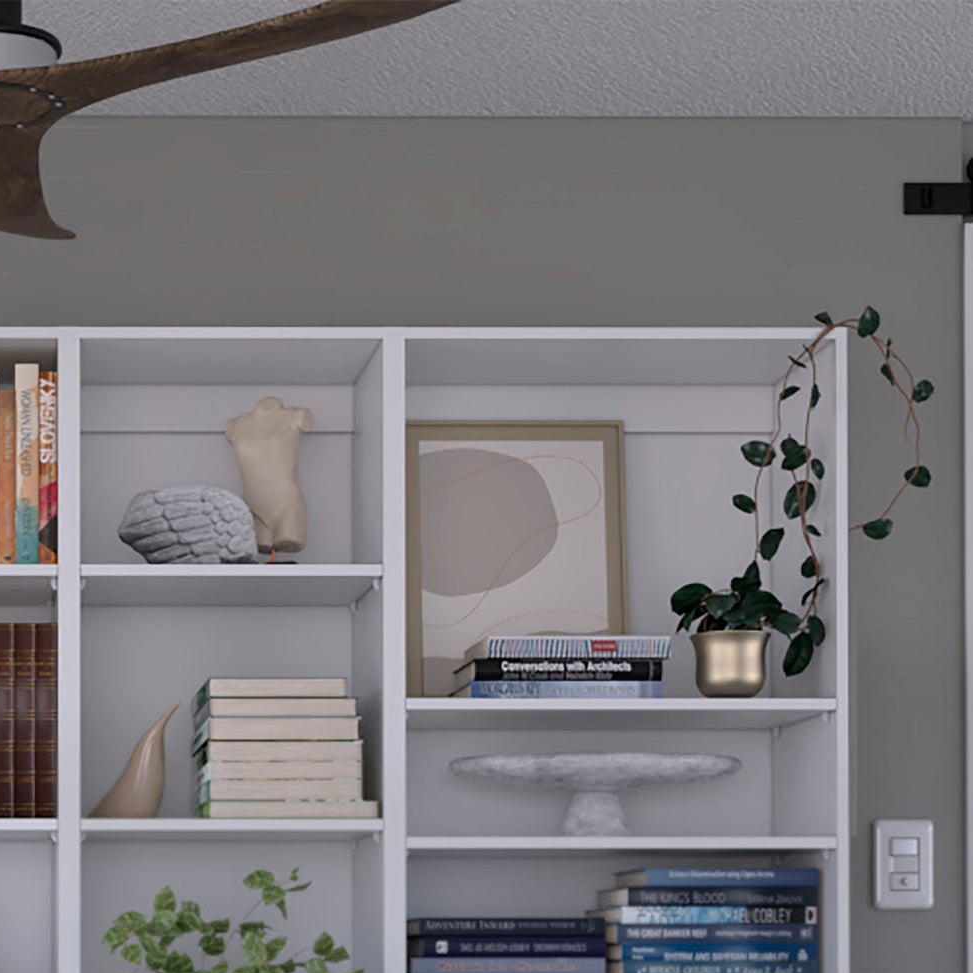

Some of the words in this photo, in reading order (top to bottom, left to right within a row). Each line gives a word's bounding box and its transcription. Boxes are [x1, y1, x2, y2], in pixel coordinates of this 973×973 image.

[501, 661, 564, 672] Conversations
[566, 661, 585, 672] with
[587, 661, 631, 672] Architects
[692, 892, 726, 904] BLOOD
[754, 909, 792, 923] COBLEY
